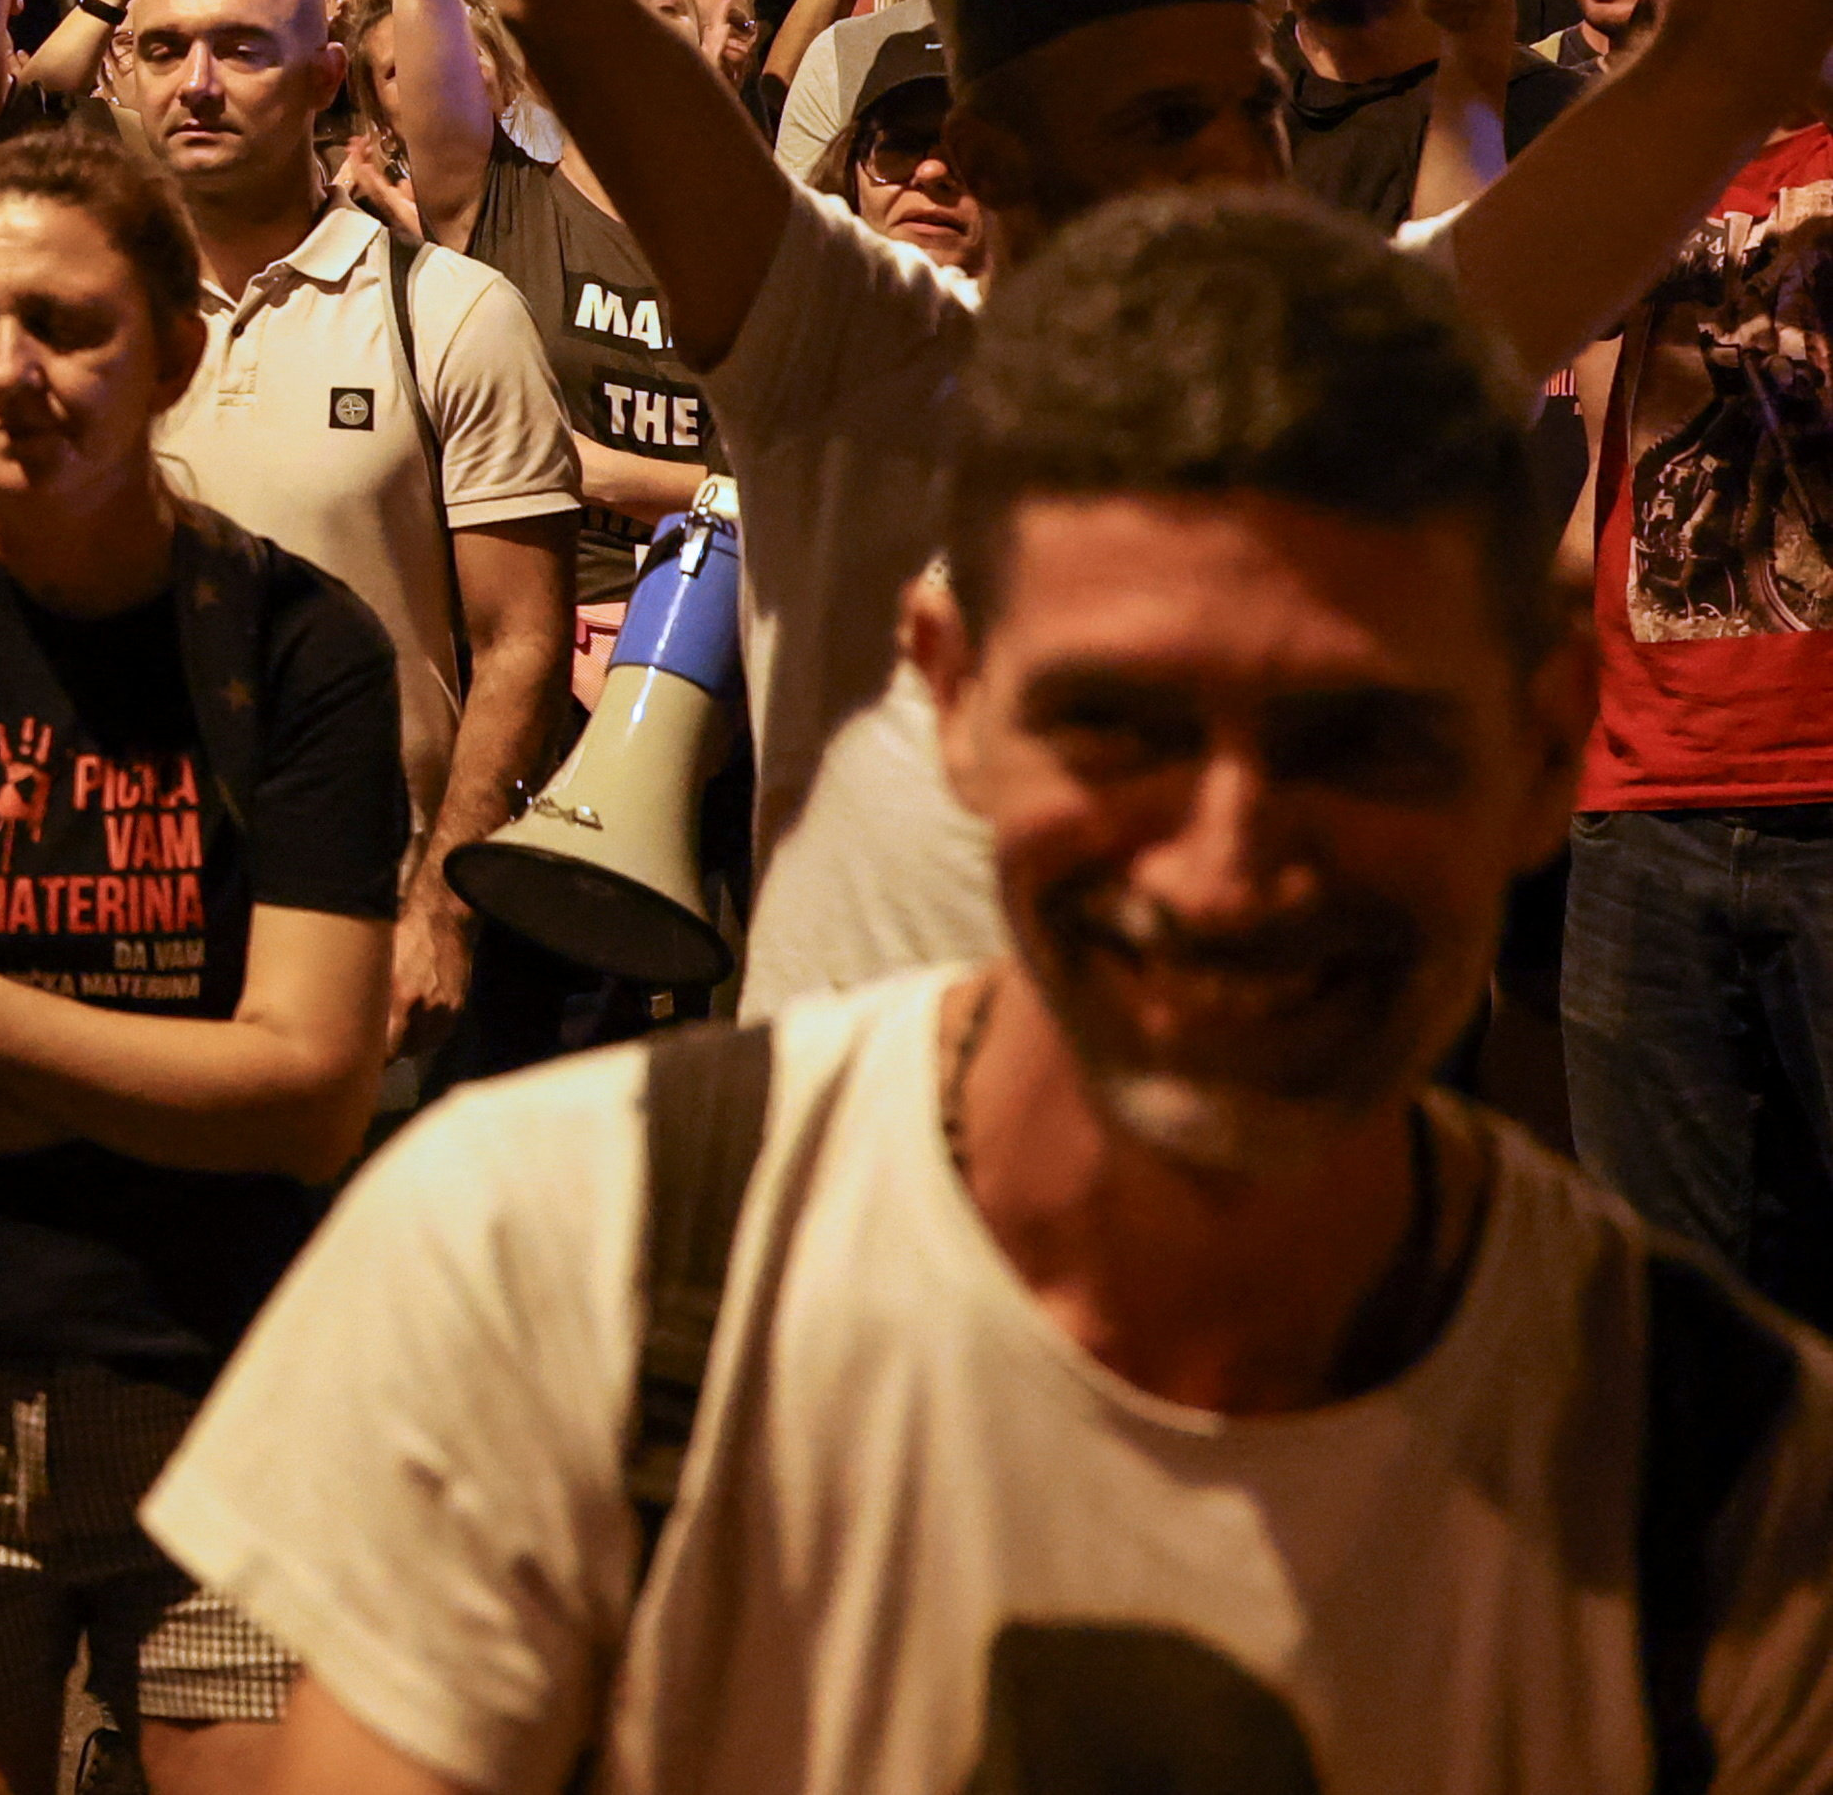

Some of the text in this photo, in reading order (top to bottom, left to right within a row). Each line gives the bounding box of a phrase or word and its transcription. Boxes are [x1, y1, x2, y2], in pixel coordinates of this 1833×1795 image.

[574, 282, 673, 350] MA
[603, 381, 700, 447] THE
[103, 809, 203, 872] VAM
[113, 937, 149, 971] DA
